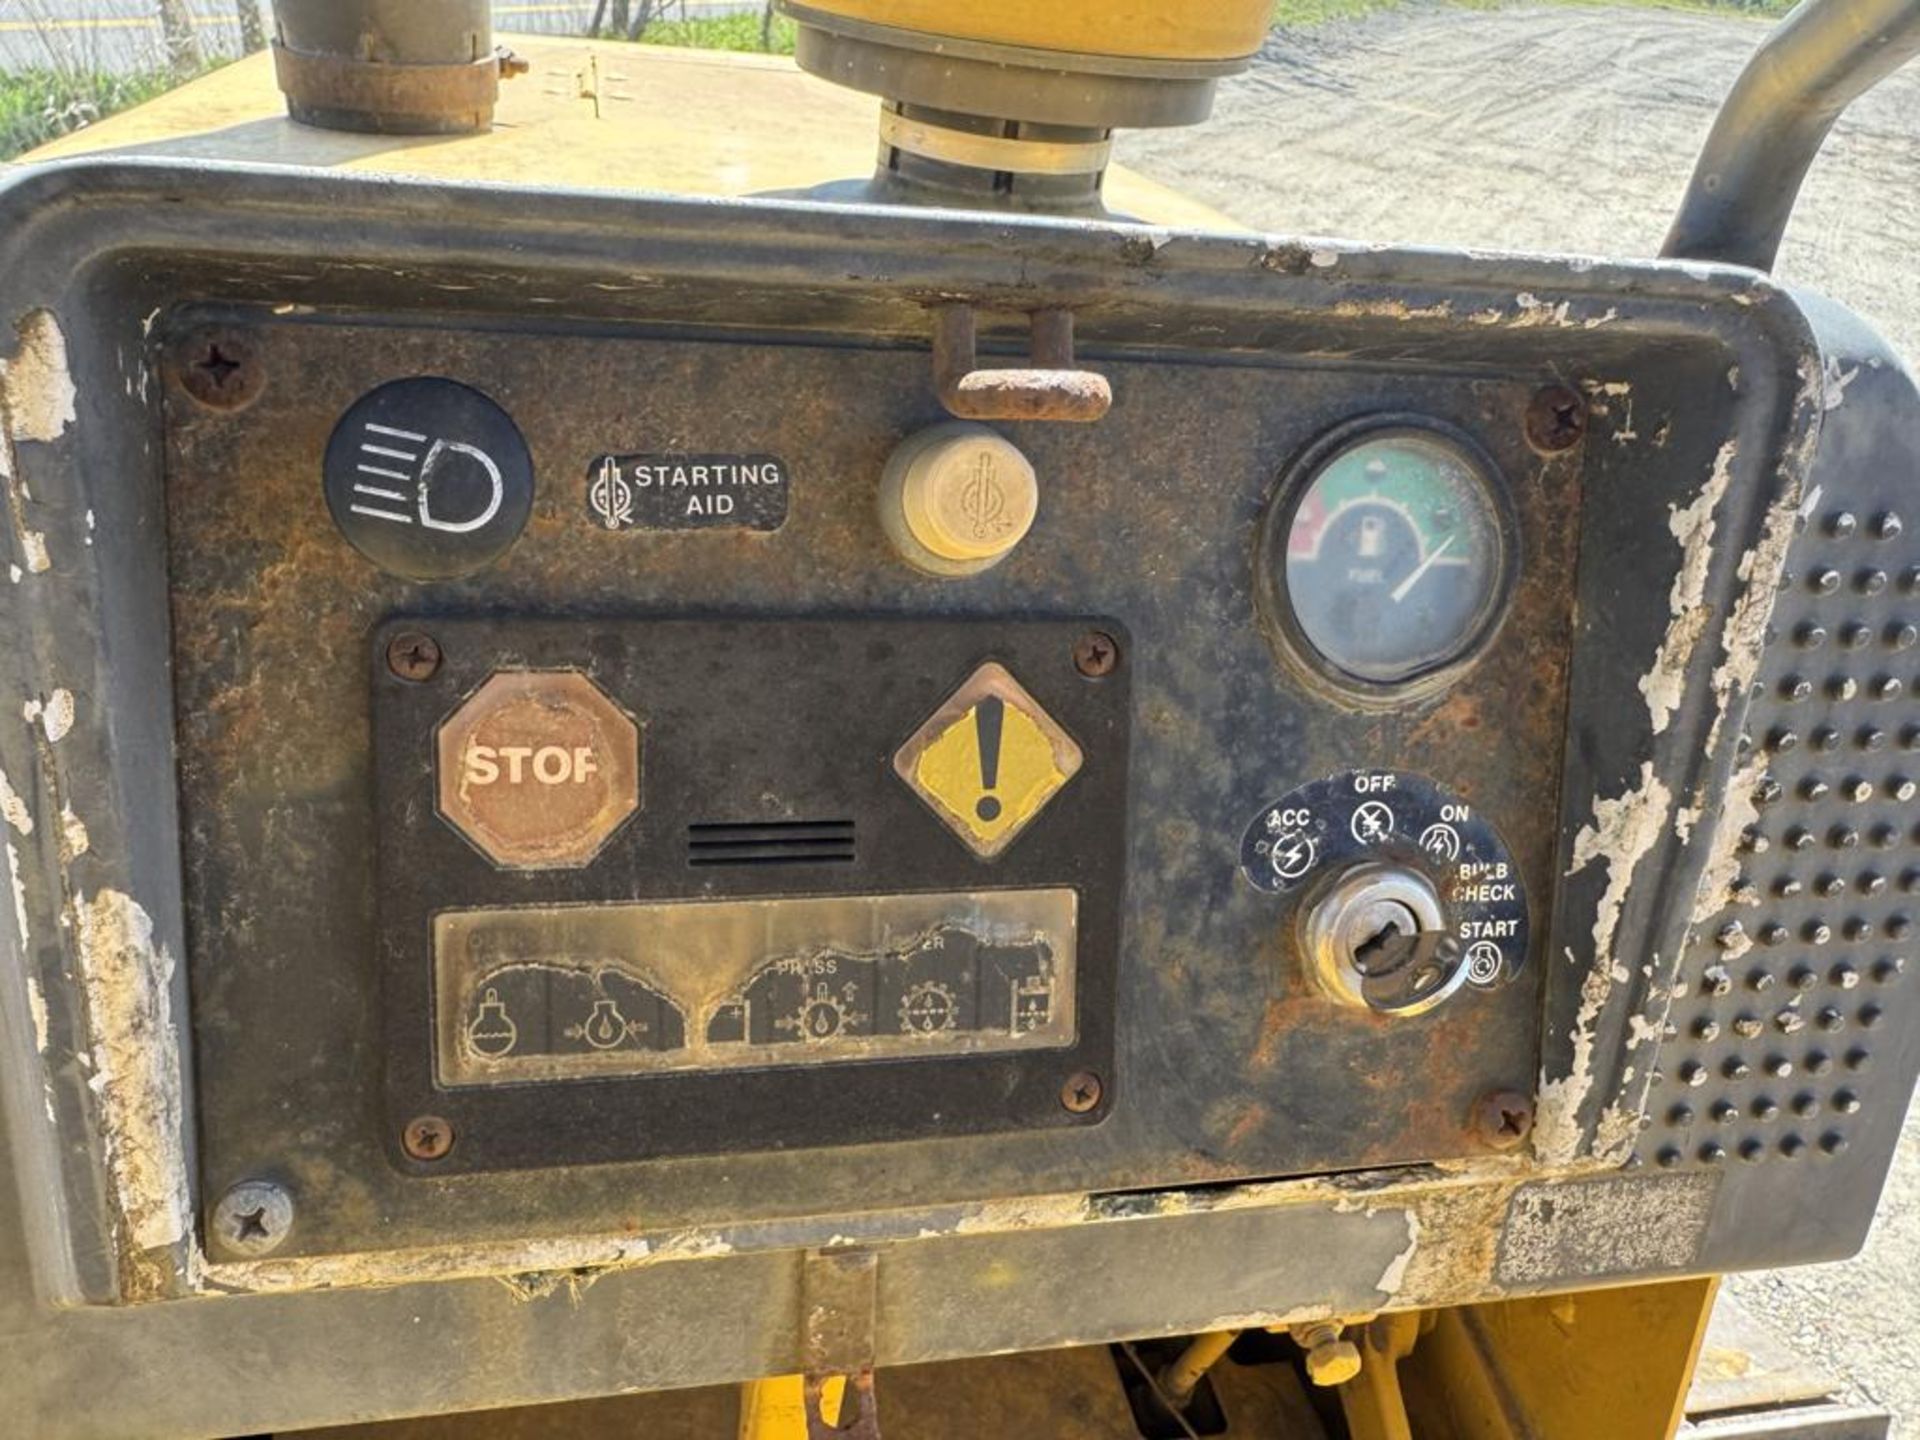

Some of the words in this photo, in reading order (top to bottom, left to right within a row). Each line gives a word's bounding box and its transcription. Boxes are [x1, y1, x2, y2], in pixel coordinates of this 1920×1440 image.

[635, 464, 779, 487] STARTING
[686, 494, 733, 515] AID
[1354, 775, 1396, 793] OFF
[1266, 808, 1310, 828] ACC
[1440, 805, 1469, 822] ON
[1453, 884, 1515, 902] CHECK
[1460, 920, 1518, 939] START
